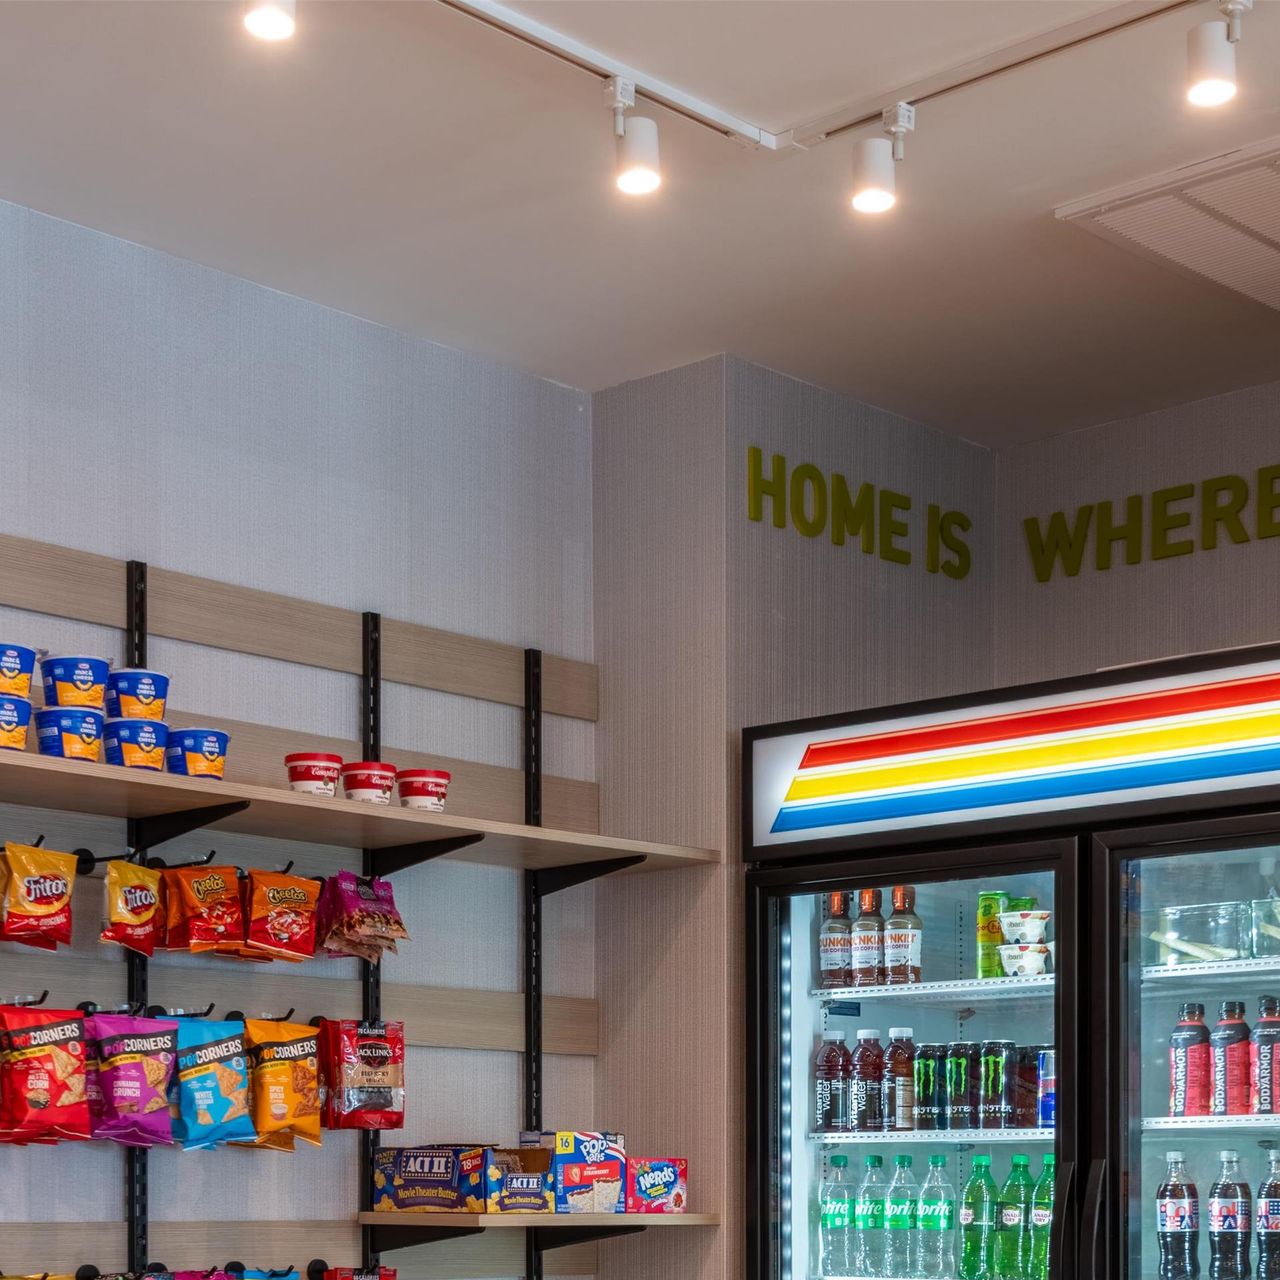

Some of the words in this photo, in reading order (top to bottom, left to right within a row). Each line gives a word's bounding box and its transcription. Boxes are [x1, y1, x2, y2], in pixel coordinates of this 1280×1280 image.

[748, 446, 911, 566] HOME
[926, 503, 973, 580] IS
[23, 876, 66, 901] Fritos
[123, 886, 156, 910] Fritos
[191, 875, 225, 901] Cheetos
[267, 887, 308, 904] Cheetos
[27, 1079, 49, 1090] CORN
[1175, 1047, 1186, 1112] BODYARMOR
[1215, 1047, 1224, 1113] BODYARMOR
[1260, 1044, 1271, 1110] BODYARMOR
[113, 1087, 141, 1097] CRUNCH
[822, 1080, 831, 1111] water
[858, 1081, 866, 1111] water
[560, 1137, 570, 1148] 16
[406, 1157, 430, 1173] ACT
[432, 1157, 447, 1172] II
[462, 1158, 472, 1171] 18
[398, 1187, 415, 1199] Movie
[415, 1186, 438, 1198] Theater
[438, 1189, 458, 1200] Butter
[511, 1178, 528, 1188] ACT
[528, 1178, 538, 1188] II
[917, 1201, 953, 1217] Sprite
